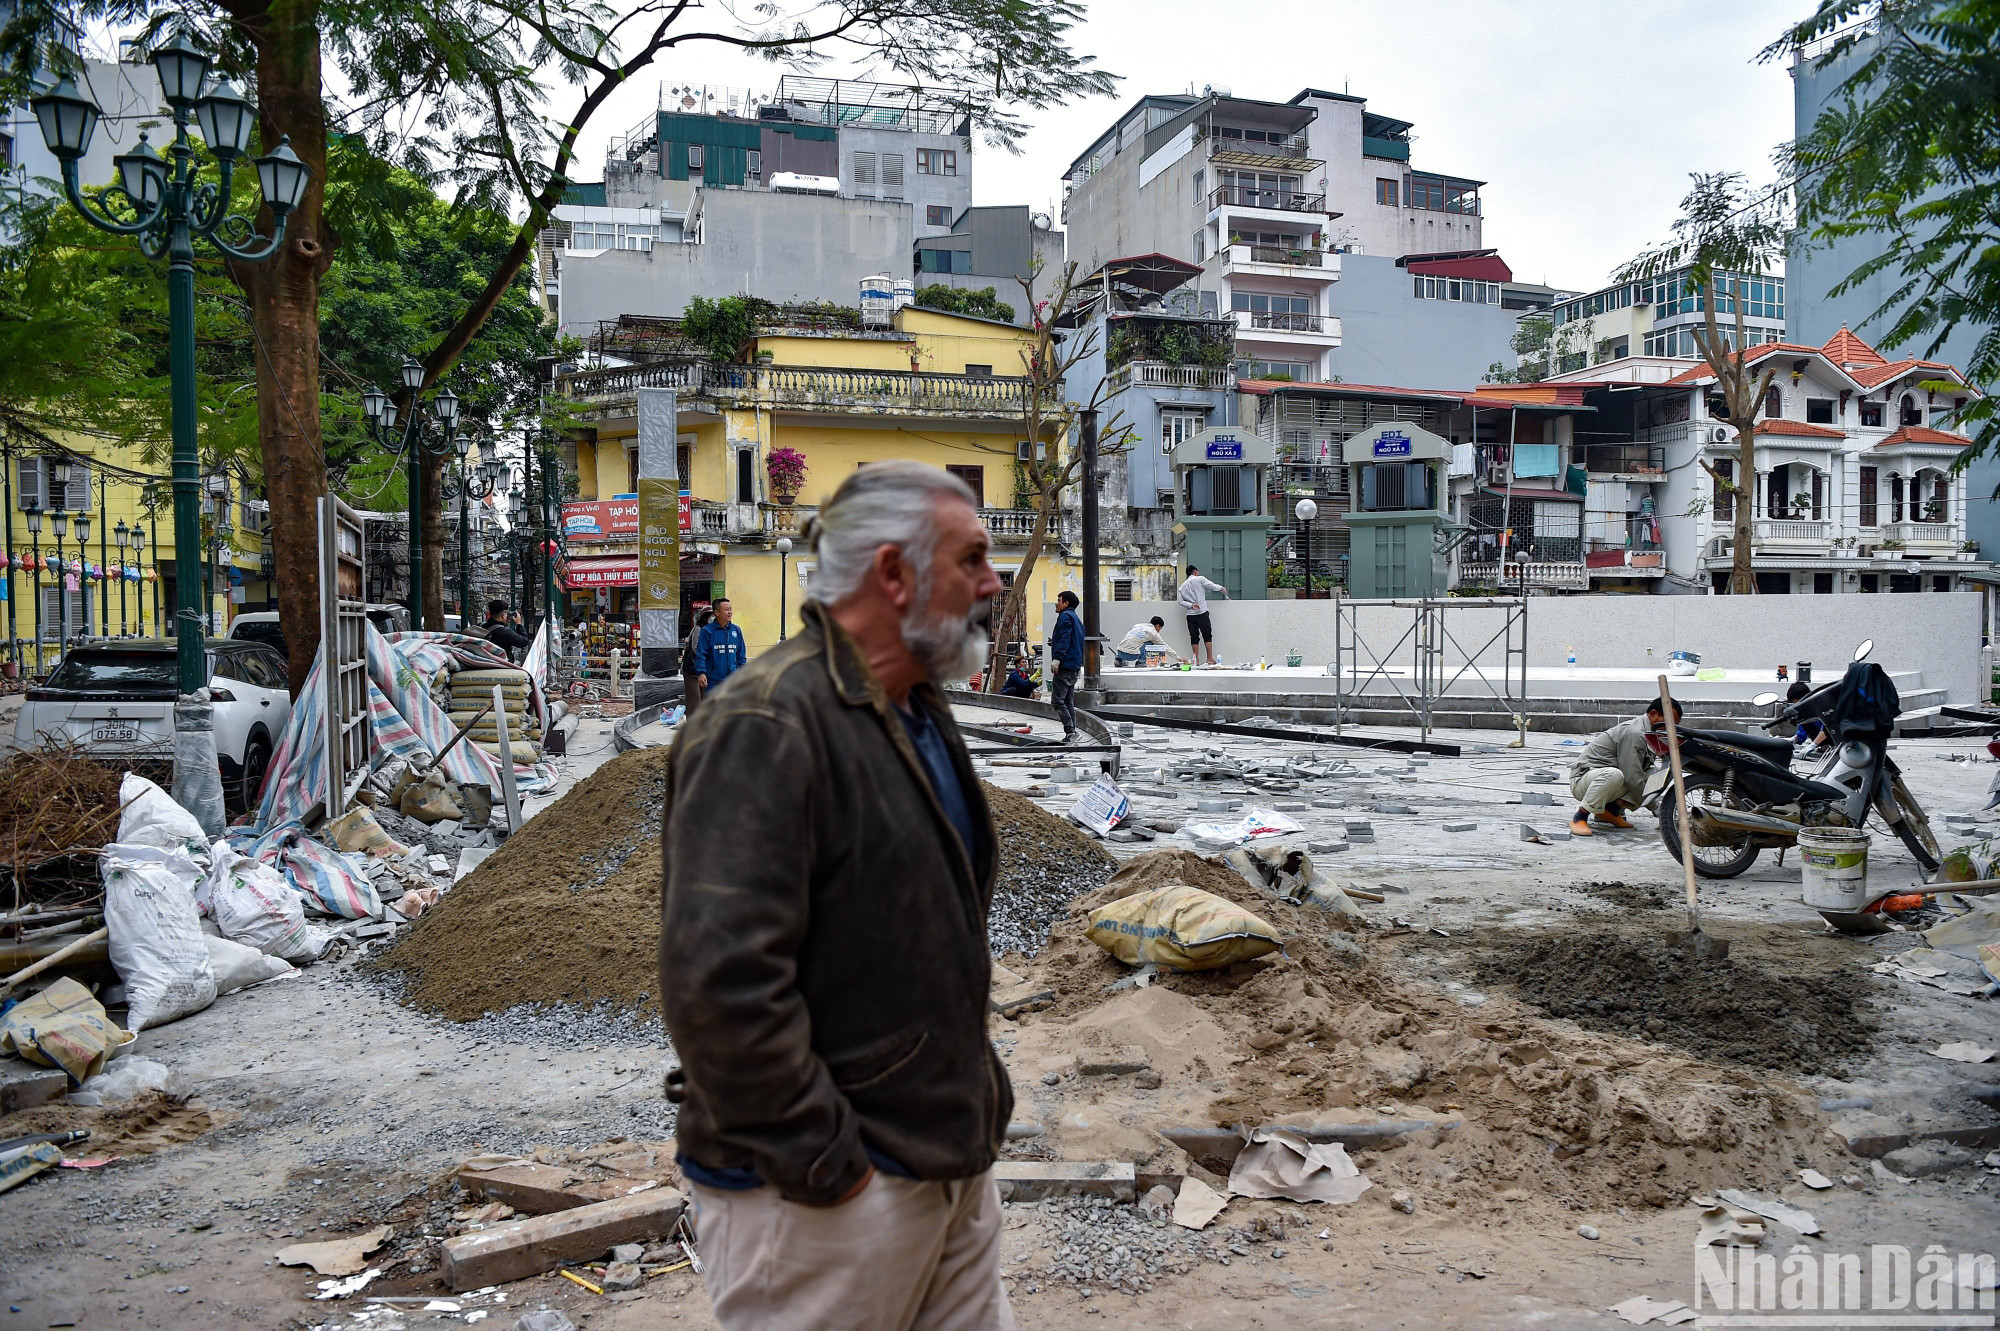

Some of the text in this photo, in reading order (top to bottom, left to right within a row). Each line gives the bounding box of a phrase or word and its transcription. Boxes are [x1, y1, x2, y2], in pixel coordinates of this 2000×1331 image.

[609, 507, 624, 519] TẠP
[572, 573, 586, 583] TẠP
[97, 730, 133, 739] 075.58
